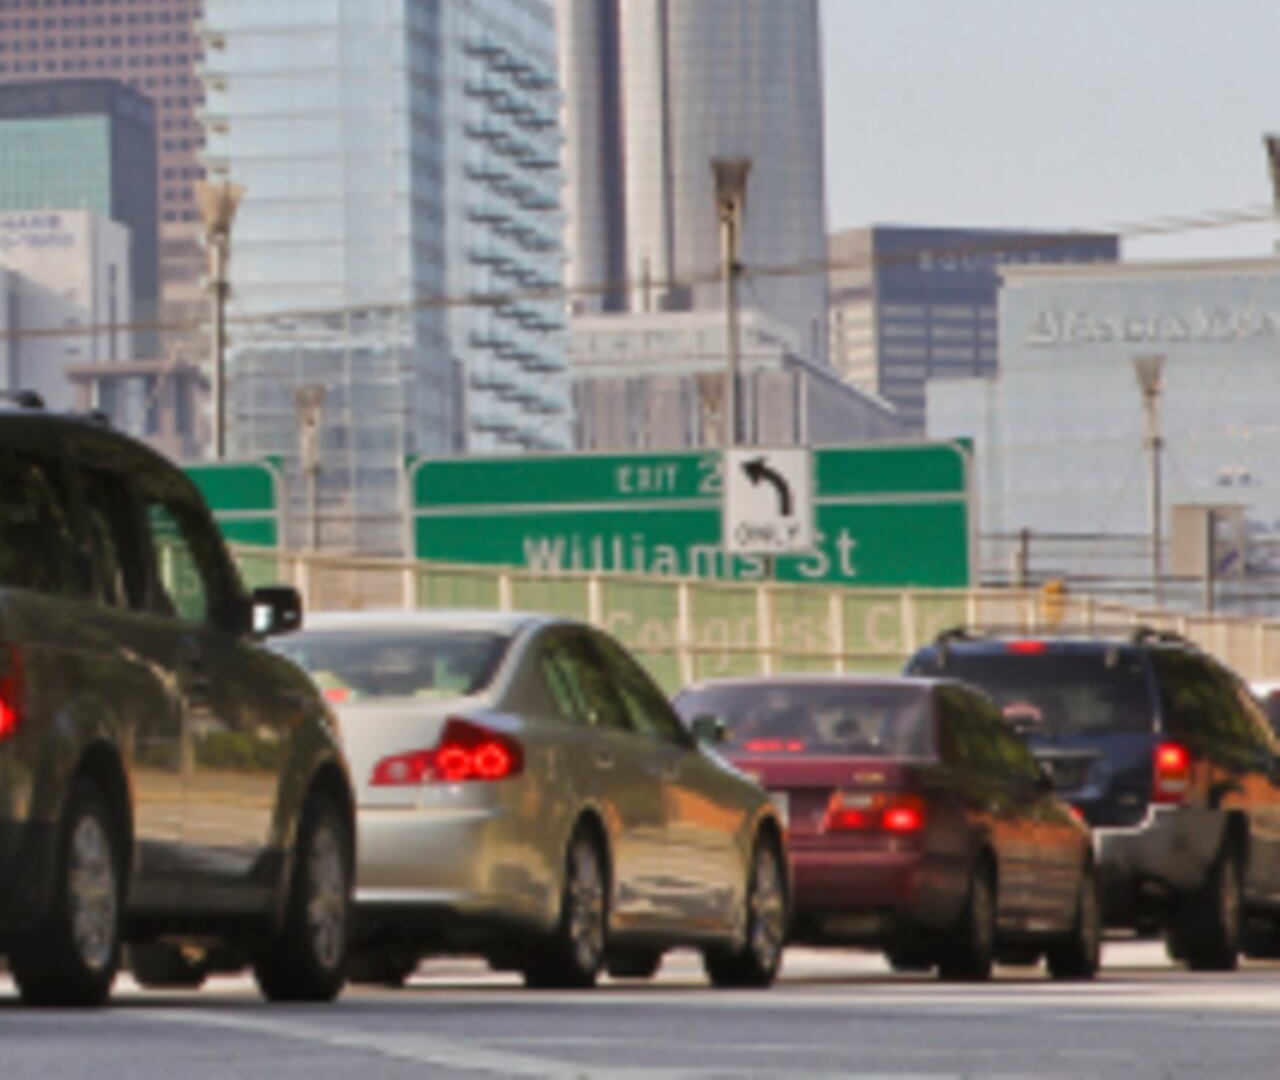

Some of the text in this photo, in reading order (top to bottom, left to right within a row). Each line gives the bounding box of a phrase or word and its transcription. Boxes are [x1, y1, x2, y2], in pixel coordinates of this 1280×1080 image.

[617, 463, 680, 493] EXIT
[522, 528, 856, 579] Williams St
[733, 521, 802, 548] ONLY
[605, 609, 837, 671] Cogress
